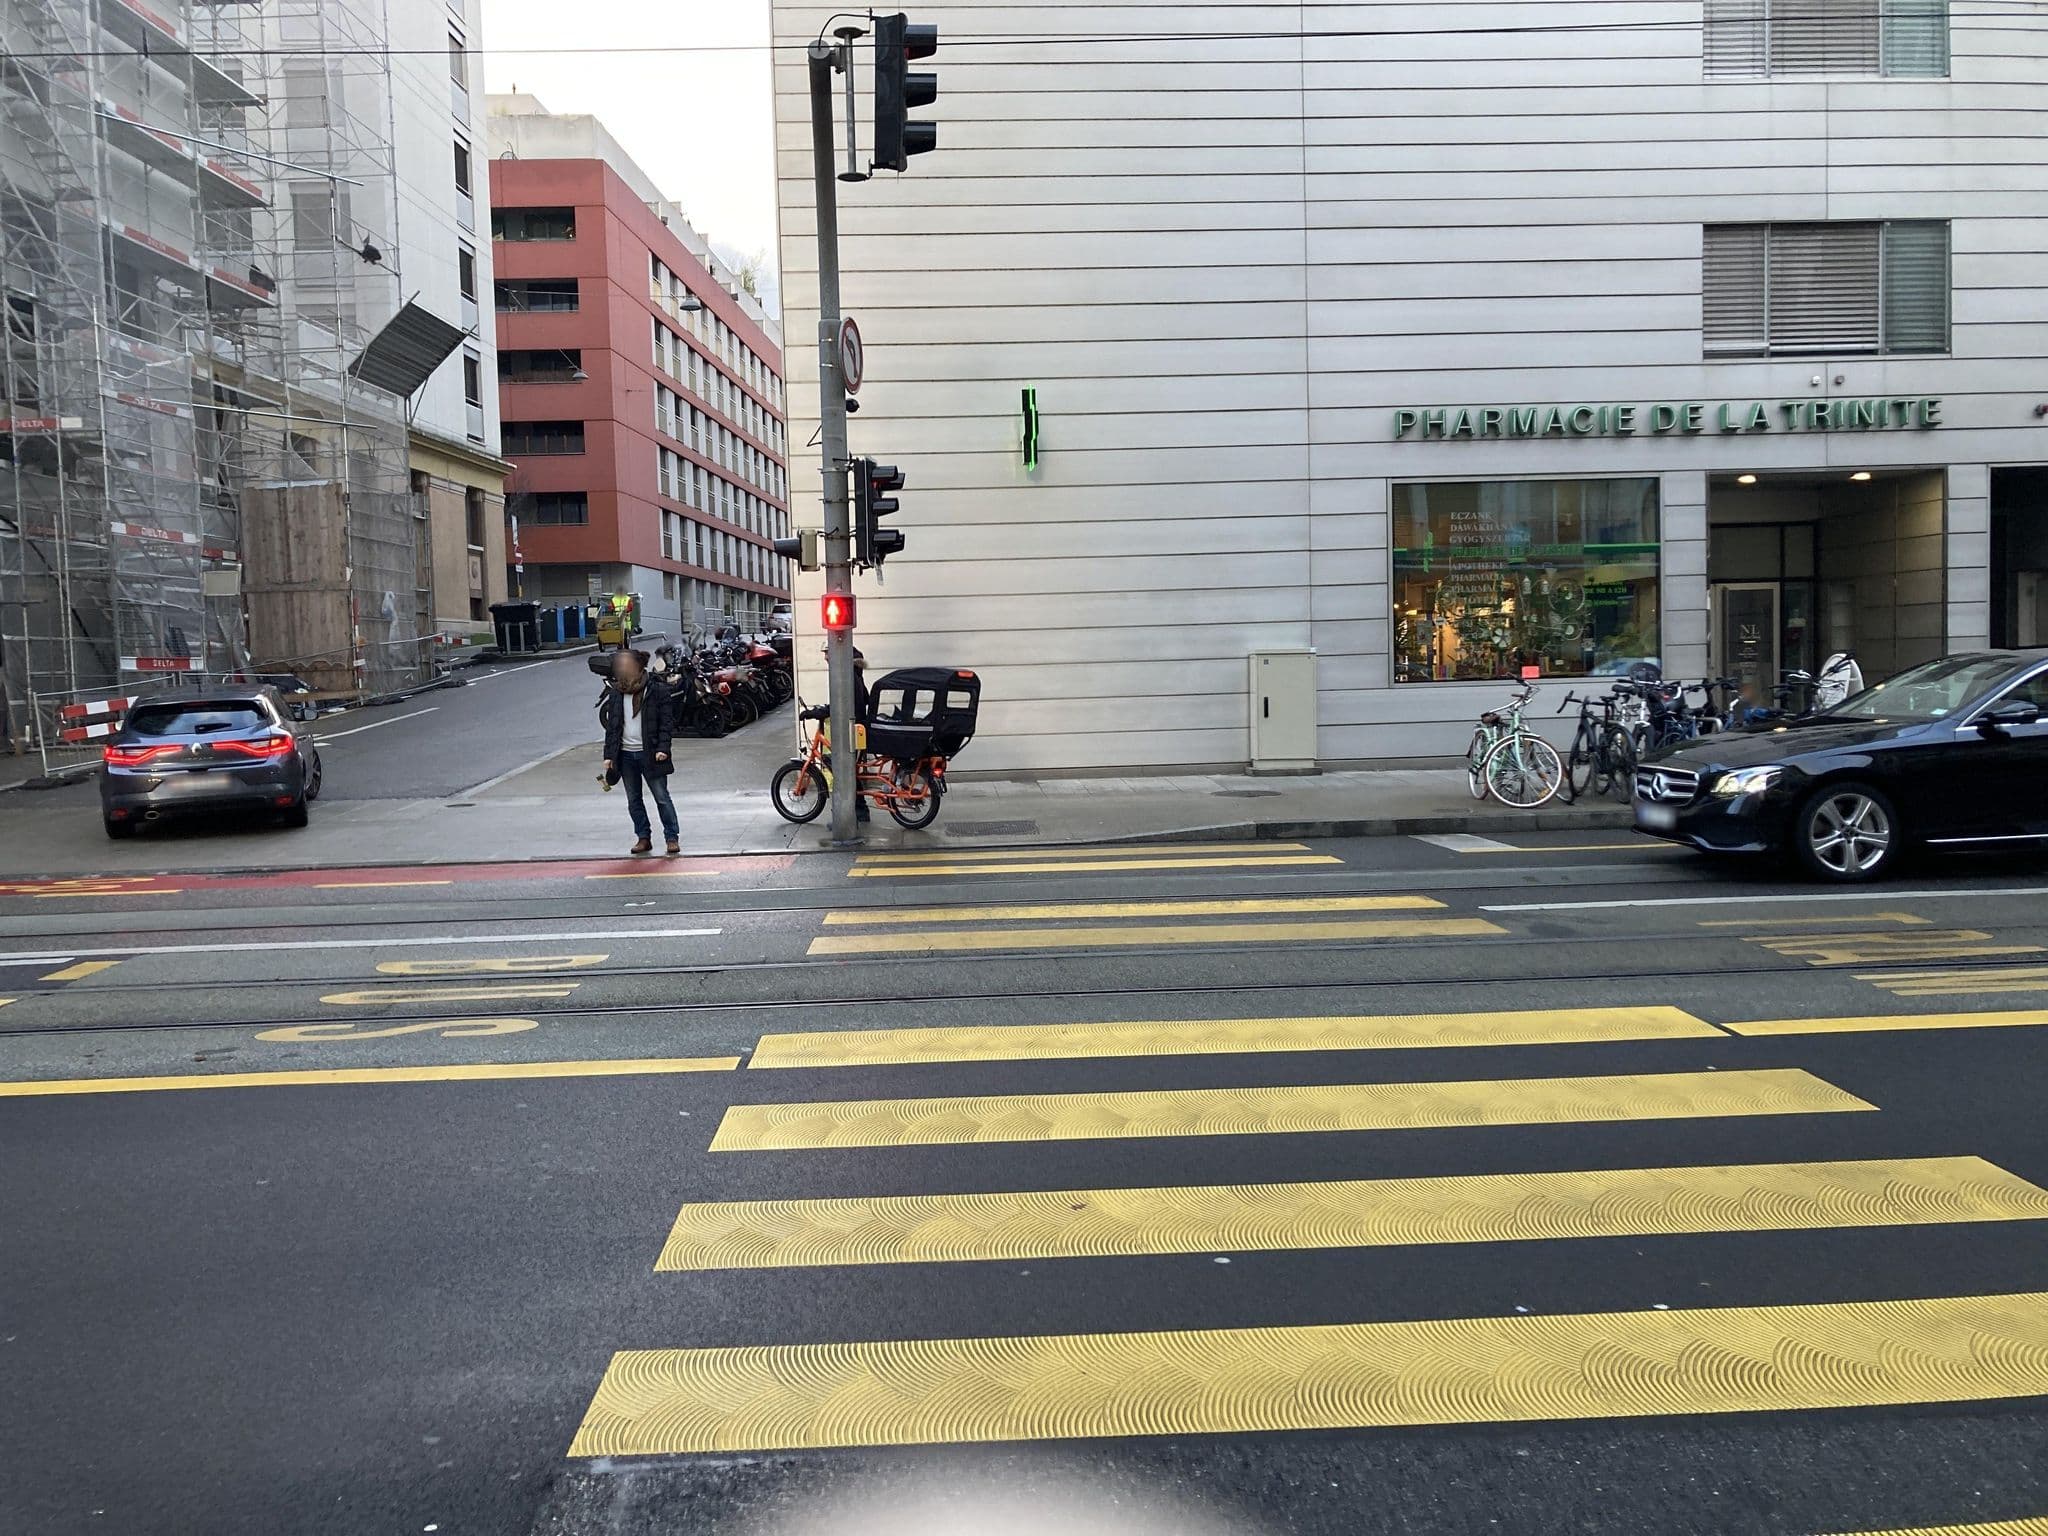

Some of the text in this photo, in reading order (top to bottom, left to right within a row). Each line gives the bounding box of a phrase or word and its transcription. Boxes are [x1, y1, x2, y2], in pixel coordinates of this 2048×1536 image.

[15, 419, 45, 428] DELTA
[1394, 399, 1943, 438] PHARMACIE DE LA TRINITE
[140, 527, 169, 540] DELTA
[152, 660, 174, 668] DELTA
[254, 954, 610, 1042] BUS
